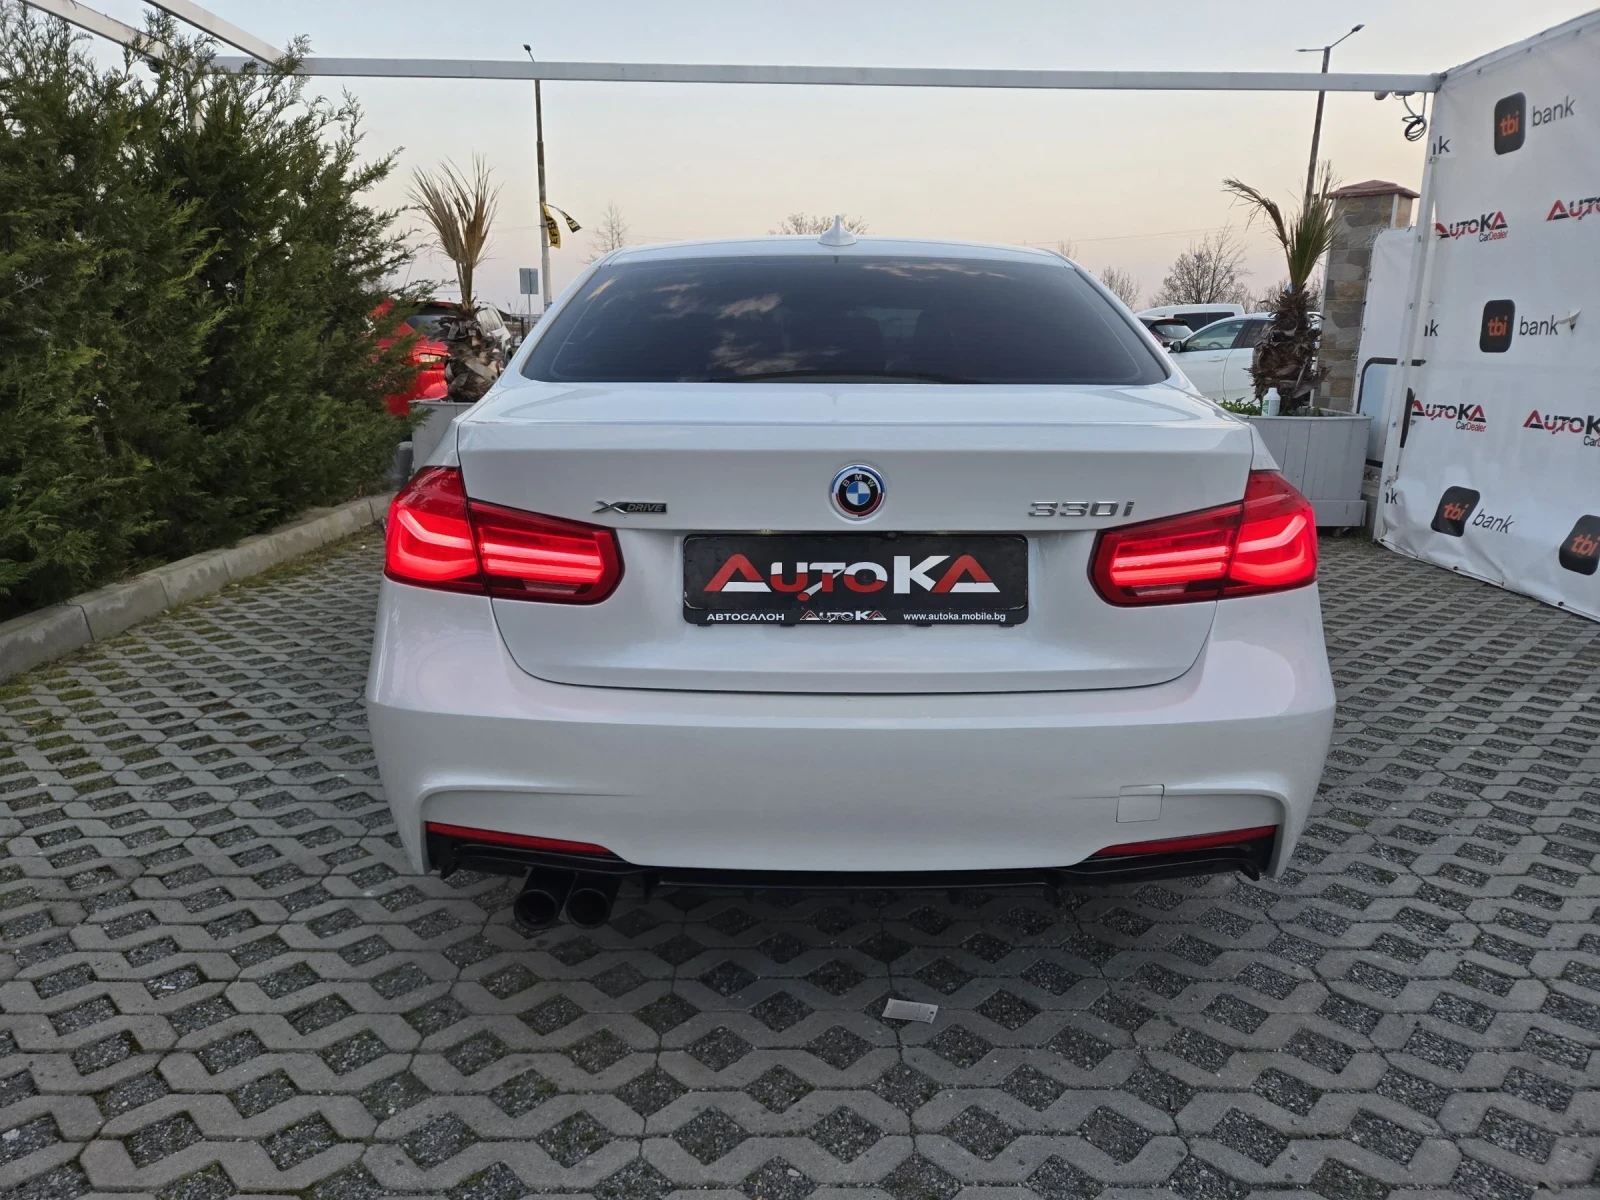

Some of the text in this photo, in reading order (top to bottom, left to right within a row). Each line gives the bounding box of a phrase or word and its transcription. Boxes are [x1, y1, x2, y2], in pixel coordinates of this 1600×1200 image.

[1500, 94, 1576, 137] tbi bank
[1487, 316, 1559, 337] tbi bank
[1027, 500, 1135, 517] 330i
[1443, 502, 1515, 534] tbi bank
[1571, 533, 1600, 557] tbi
[706, 613, 785, 621] АВТОСАЛОН
[903, 612, 1006, 622] www.autoka.mobile.bg
